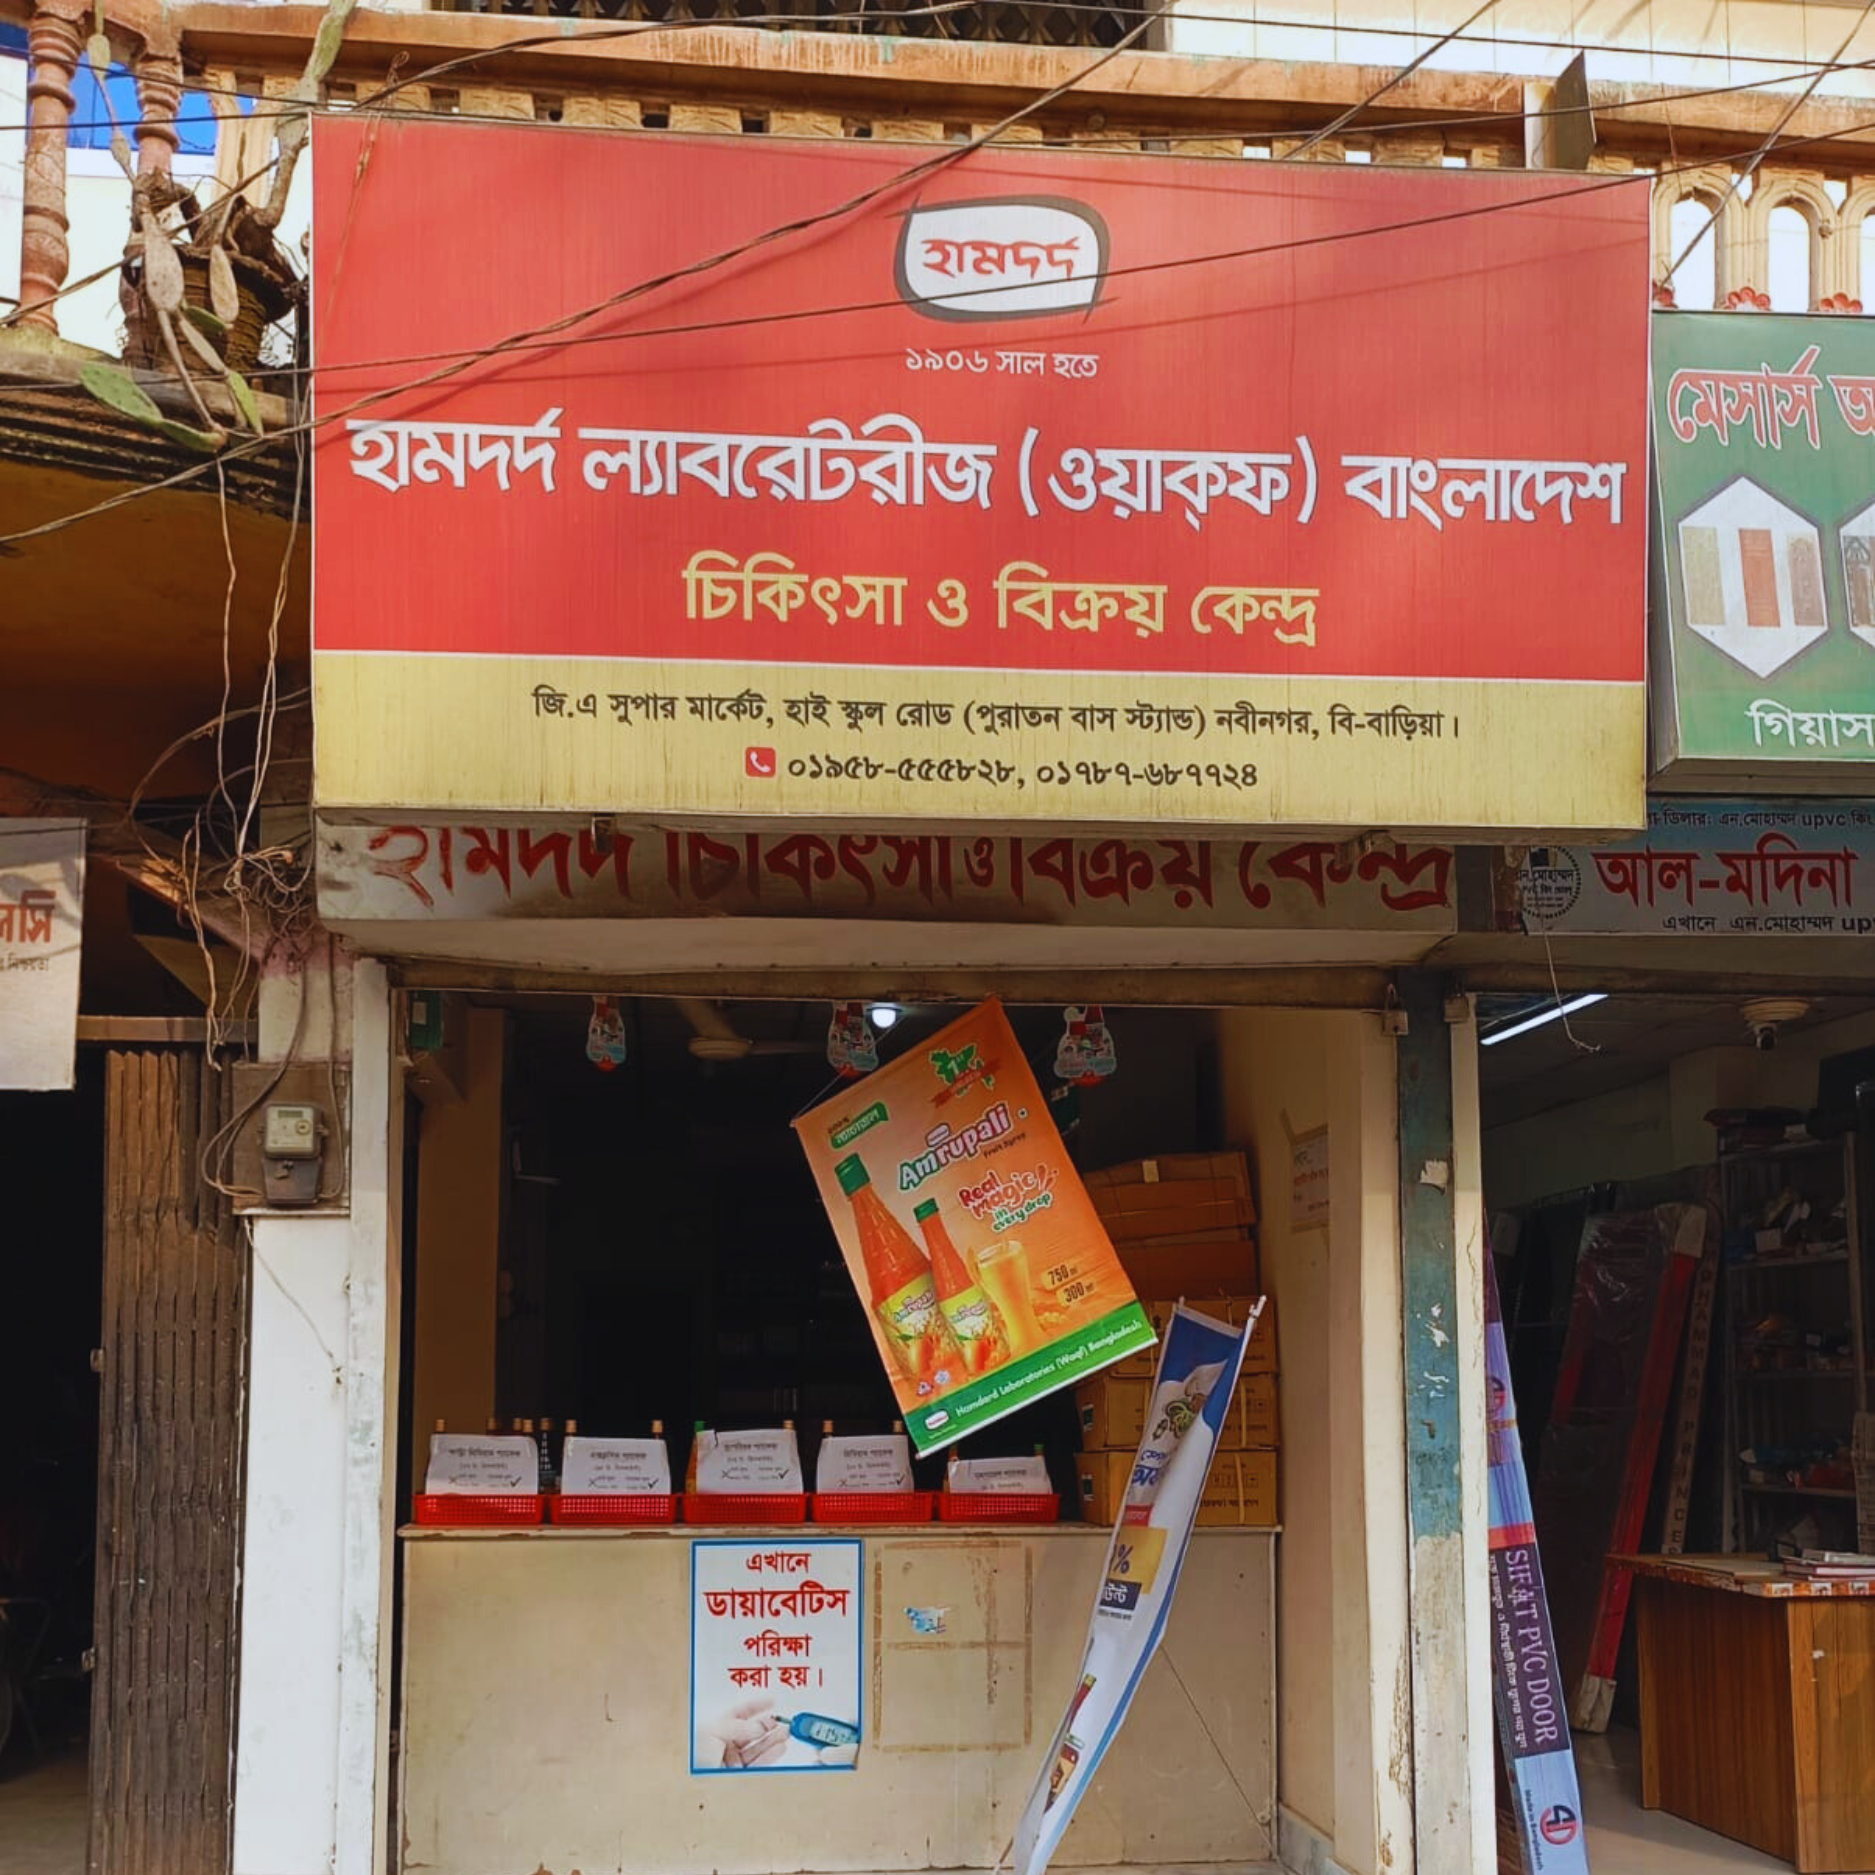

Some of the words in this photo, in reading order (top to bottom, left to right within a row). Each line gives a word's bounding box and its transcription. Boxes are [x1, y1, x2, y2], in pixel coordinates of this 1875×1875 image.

[921, 236, 1081, 281] হামদর্দ
[906, 348, 989, 373] ১৯০৬
[995, 351, 1047, 375] সাল
[1052, 353, 1099, 378] হতে
[1667, 344, 1824, 450] মেসার্স
[345, 407, 564, 493] হামদর্দ
[577, 413, 998, 510] ল্যাবরেটরীজ
[1340, 454, 1628, 531] বাংলাদেশ
[681, 549, 909, 627] চিকিৎসা
[926, 578, 970, 628] ও
[992, 560, 1169, 639] বিক্রয়
[1190, 586, 1321, 647] কেন্দ্র
[532, 684, 598, 719] জি.এ
[608, 693, 678, 726] সুপার
[686, 688, 774, 729] মার্কেট,
[783, 691, 832, 728] হাই
[838, 699, 887, 733] স্কুল
[896, 700, 955, 728] রোড
[963, 700, 1063, 735] (পুরাতন
[1069, 703, 1118, 732] বাস
[1214, 700, 1320, 741] নবীনগর,
[788, 755, 1026, 790] ০১৯৫৮-৫৫৫৮২৮,
[1036, 761, 1258, 790] ০১৭৮৭-৬৮৭৭২৪
[1801, 811, 1847, 831] upvc
[1662, 915, 1717, 933] এখানে
[1729, 914, 1834, 933] এন.মোহাম্মদ
[899, 1103, 1013, 1192] Amrupali
[958, 1171, 1000, 1208] Real
[1047, 1264, 1070, 1286] 750
[1063, 1282, 1085, 1304] 300
[956, 1389, 999, 1417] Hamdard
[999, 1362, 1056, 1397] Laboratories
[1088, 1319, 1142, 1352] Bangladesh
[746, 1550, 811, 1574] এখানে
[704, 1579, 850, 1619] ডায়াবেটিস
[743, 1629, 812, 1657] পরিক্ষা
[1518, 1626, 1550, 1674] PVC
[727, 1664, 771, 1688] করা
[1527, 1678, 1559, 1745] DOOR
